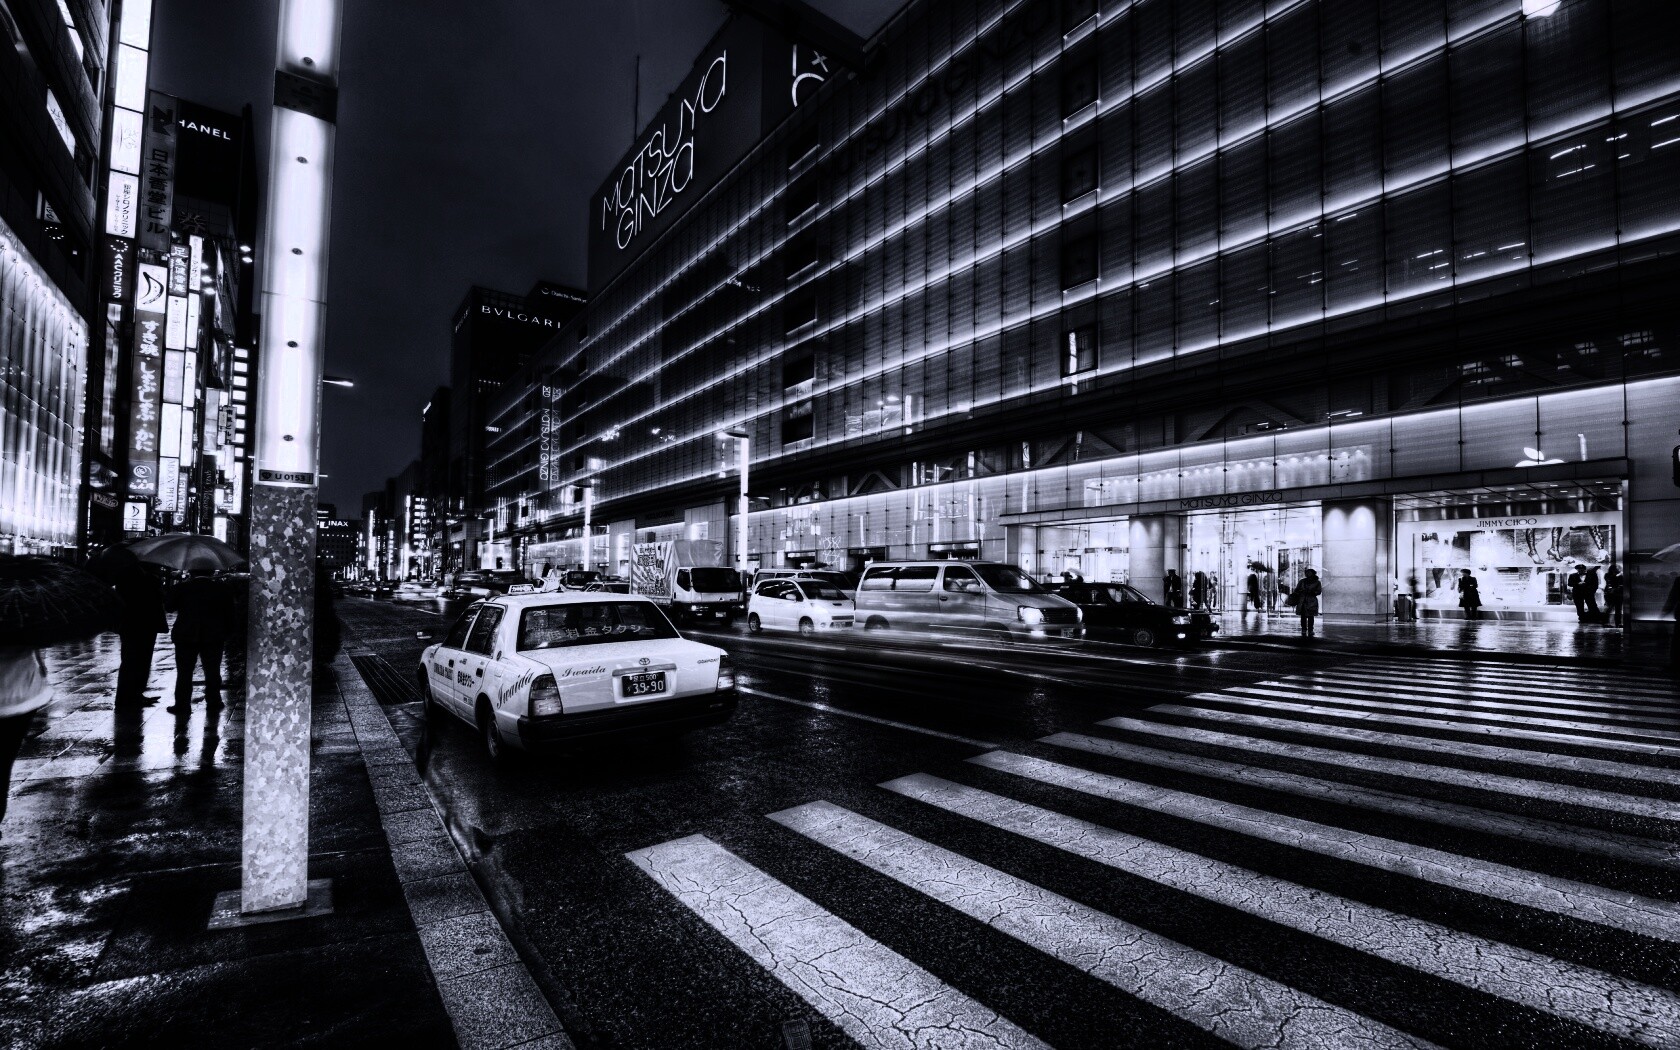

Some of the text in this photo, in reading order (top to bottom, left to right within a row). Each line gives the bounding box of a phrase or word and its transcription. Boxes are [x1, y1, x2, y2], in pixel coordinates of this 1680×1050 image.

[481, 305, 562, 329] BVLGARI
[284, 474, 305, 482] 0153
[175, 475, 186, 523] CHAUMET
[1476, 517, 1537, 528] JIMMY CHOO
[561, 665, 607, 678] Iwaida
[496, 668, 535, 710] Iwaida
